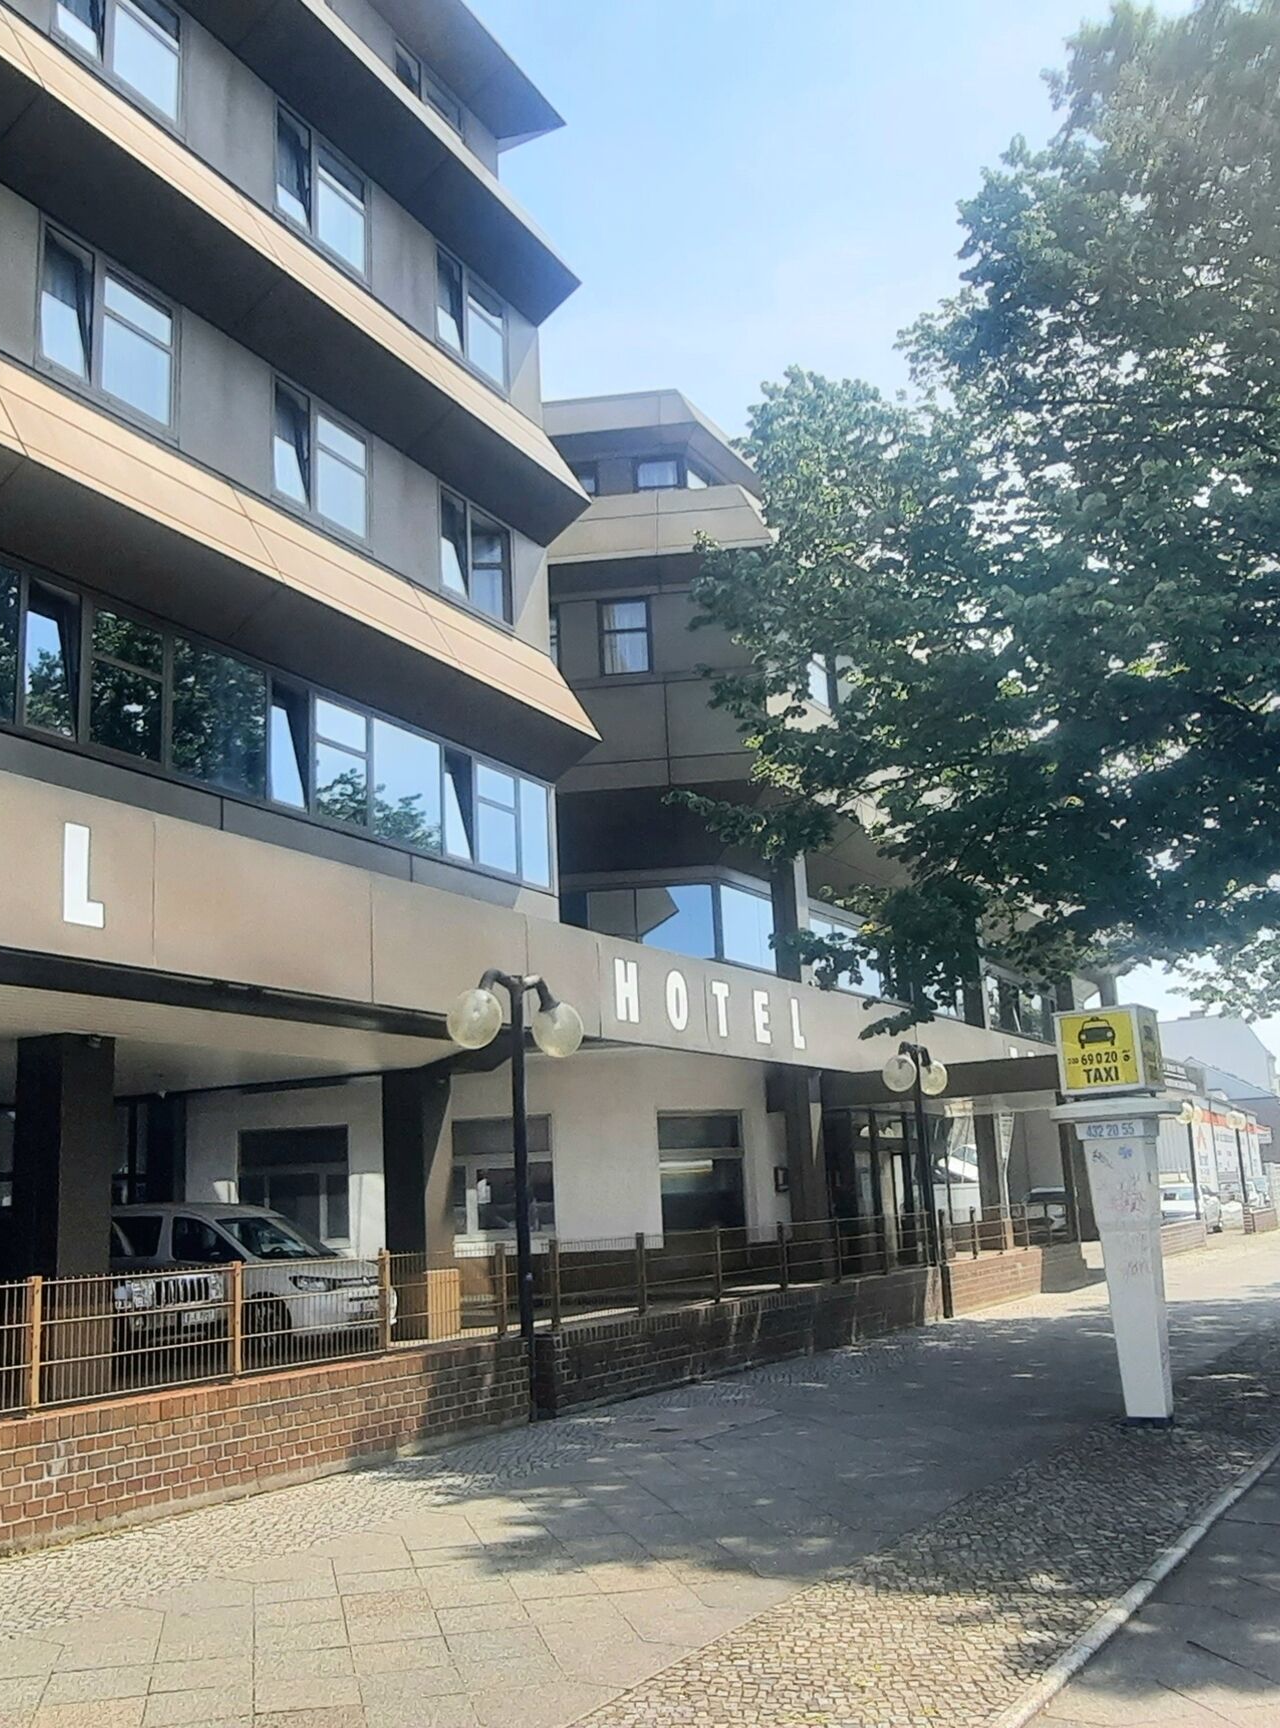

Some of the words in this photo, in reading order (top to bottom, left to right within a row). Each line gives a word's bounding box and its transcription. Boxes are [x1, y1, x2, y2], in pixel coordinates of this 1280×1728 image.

[614, 957, 807, 1050] HOTEL
[1082, 1065, 1120, 1084] TAXI
[1086, 1124, 1105, 1138] 432
[1105, 1124, 1119, 1137] 20
[1121, 1122, 1135, 1136] 55
